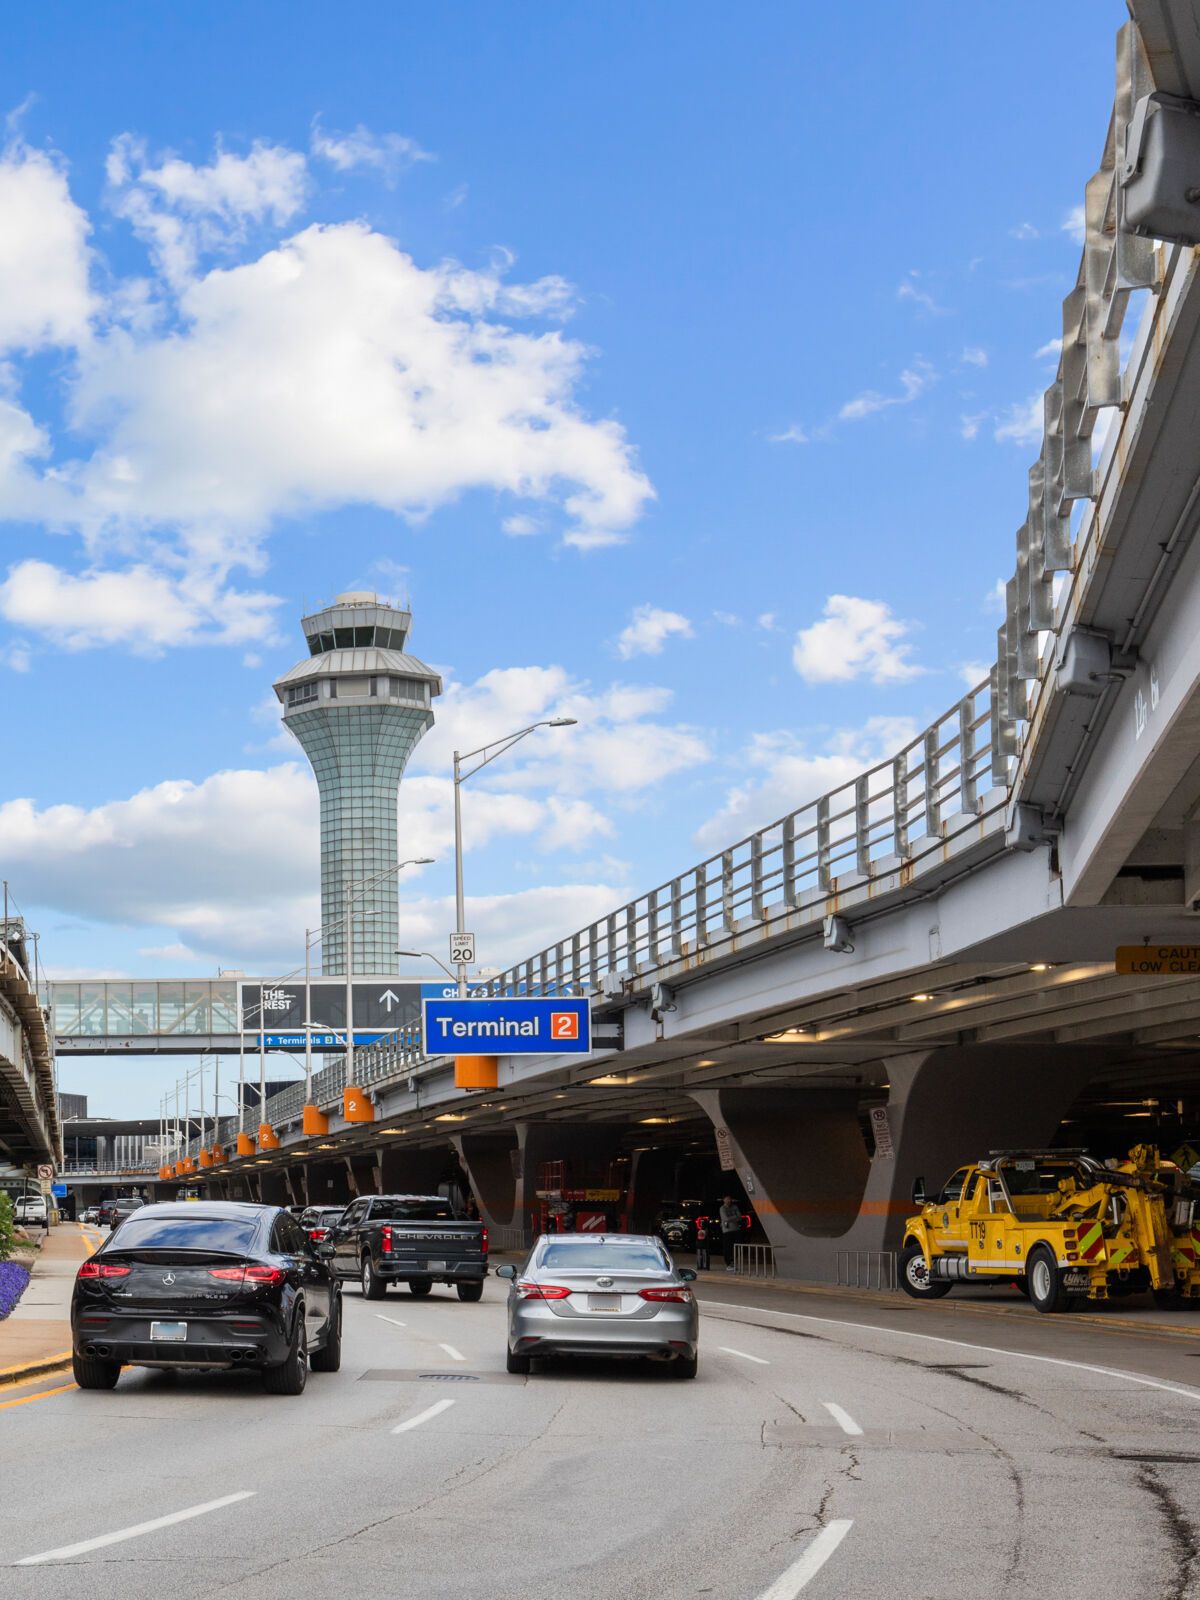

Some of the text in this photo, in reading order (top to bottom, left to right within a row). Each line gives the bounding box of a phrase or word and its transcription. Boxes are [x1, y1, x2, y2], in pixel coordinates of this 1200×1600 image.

[452, 949, 473, 961] 20
[1131, 961, 1162, 973] LOW
[263, 990, 285, 1000] THE
[263, 1000, 292, 1010] REST
[436, 1016, 572, 1037] Terminal 2
[348, 1101, 357, 1112] 2
[969, 1221, 986, 1240] TT19
[398, 1232, 478, 1241] CHEVROLET
